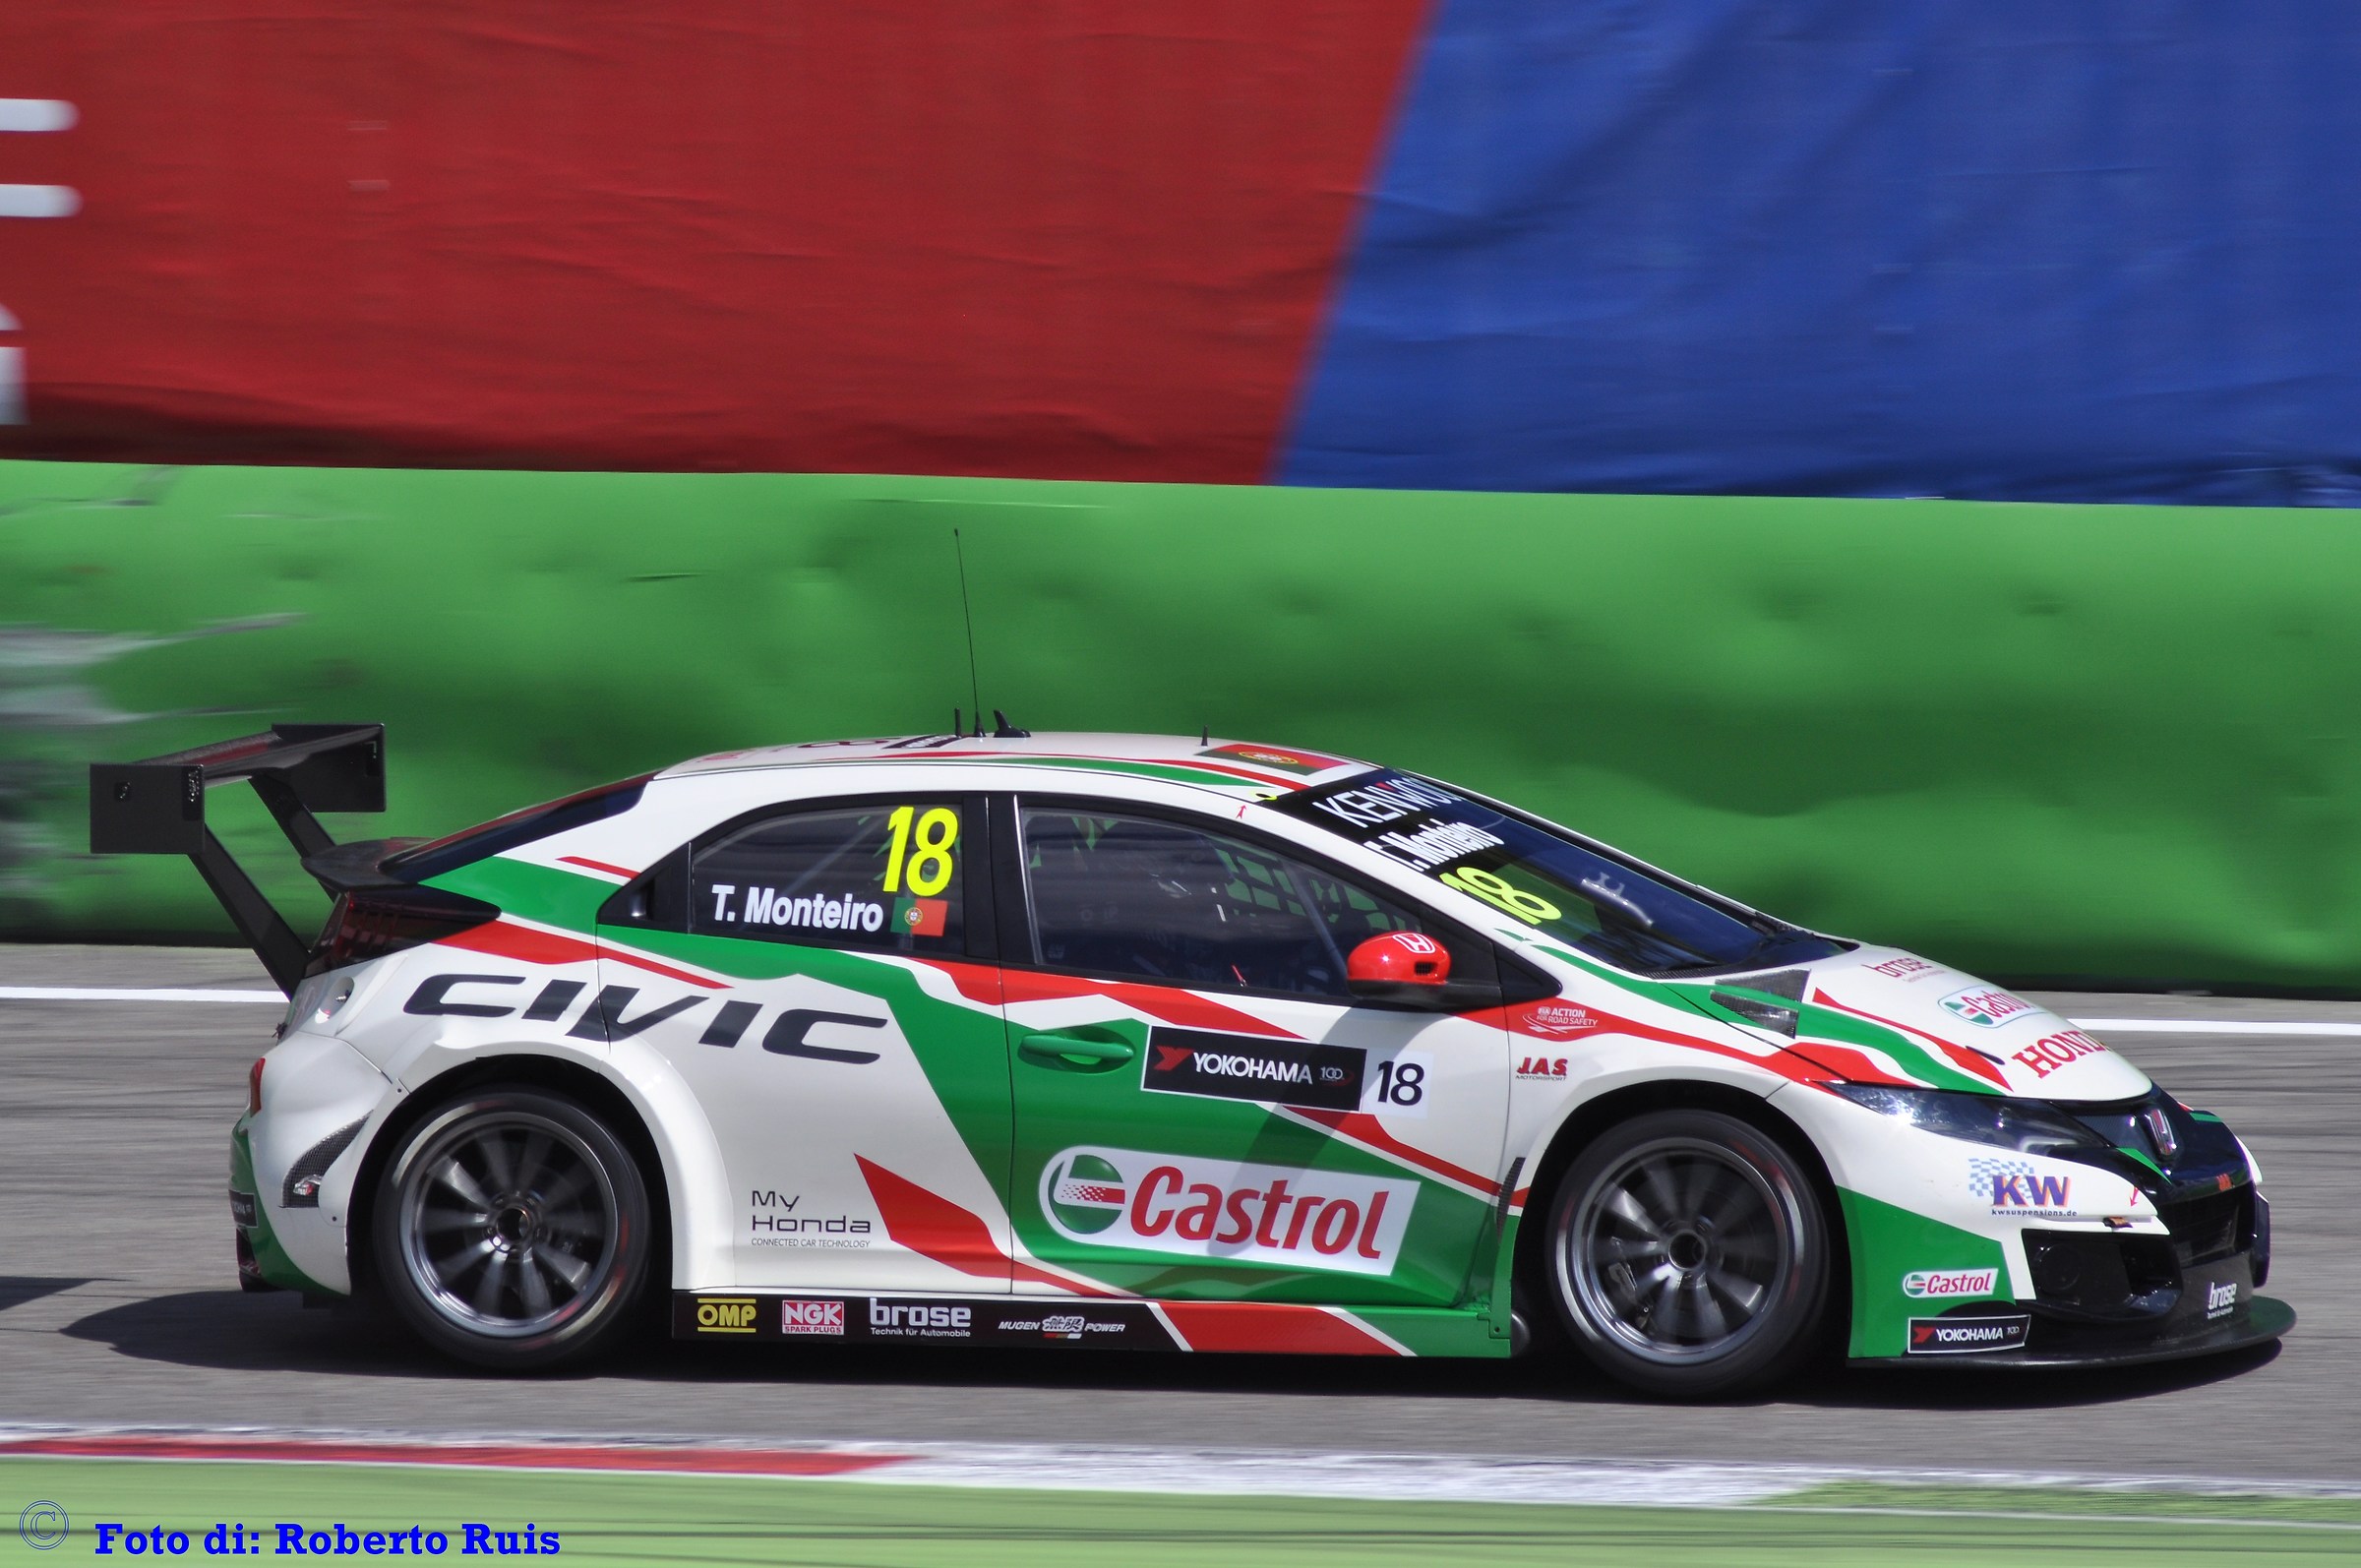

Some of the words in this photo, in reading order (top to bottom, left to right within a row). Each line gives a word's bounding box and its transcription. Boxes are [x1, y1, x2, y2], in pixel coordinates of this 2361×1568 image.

[882, 806, 959, 897] 18
[711, 883, 736, 923] T.
[743, 885, 884, 933] Monteiro
[1438, 867, 1562, 926] 18
[402, 973, 889, 1065] CIVIC
[1551, 1007, 1586, 1018] ACTION
[1569, 1017, 1599, 1026] SAFETY
[1517, 1056, 1568, 1076] JAS
[2011, 1030, 2106, 1079] HOND
[1192, 1052, 1313, 1085] YOKOHAMA
[1377, 1060, 1425, 1107] 18
[752, 1189, 800, 1212] My
[1992, 1175, 2072, 1208] KW
[752, 1215, 871, 1234] Honda
[1129, 1165, 1390, 1261] Castrol
[751, 1237, 799, 1246] CONNECTED
[801, 1238, 817, 1247] CAR
[818, 1239, 871, 1248] TECHNOLOGY
[1927, 1273, 1991, 1295] Castrol
[697, 1304, 757, 1326] OMP
[784, 1303, 842, 1326] NGK
[870, 1297, 971, 1328] brose
[871, 1327, 904, 1336] Technik
[920, 1329, 971, 1338] Automobile
[999, 1321, 1040, 1330] MUGEN
[1084, 1322, 1126, 1332] POWER
[1936, 1327, 2004, 1342] YOKOHAMA
